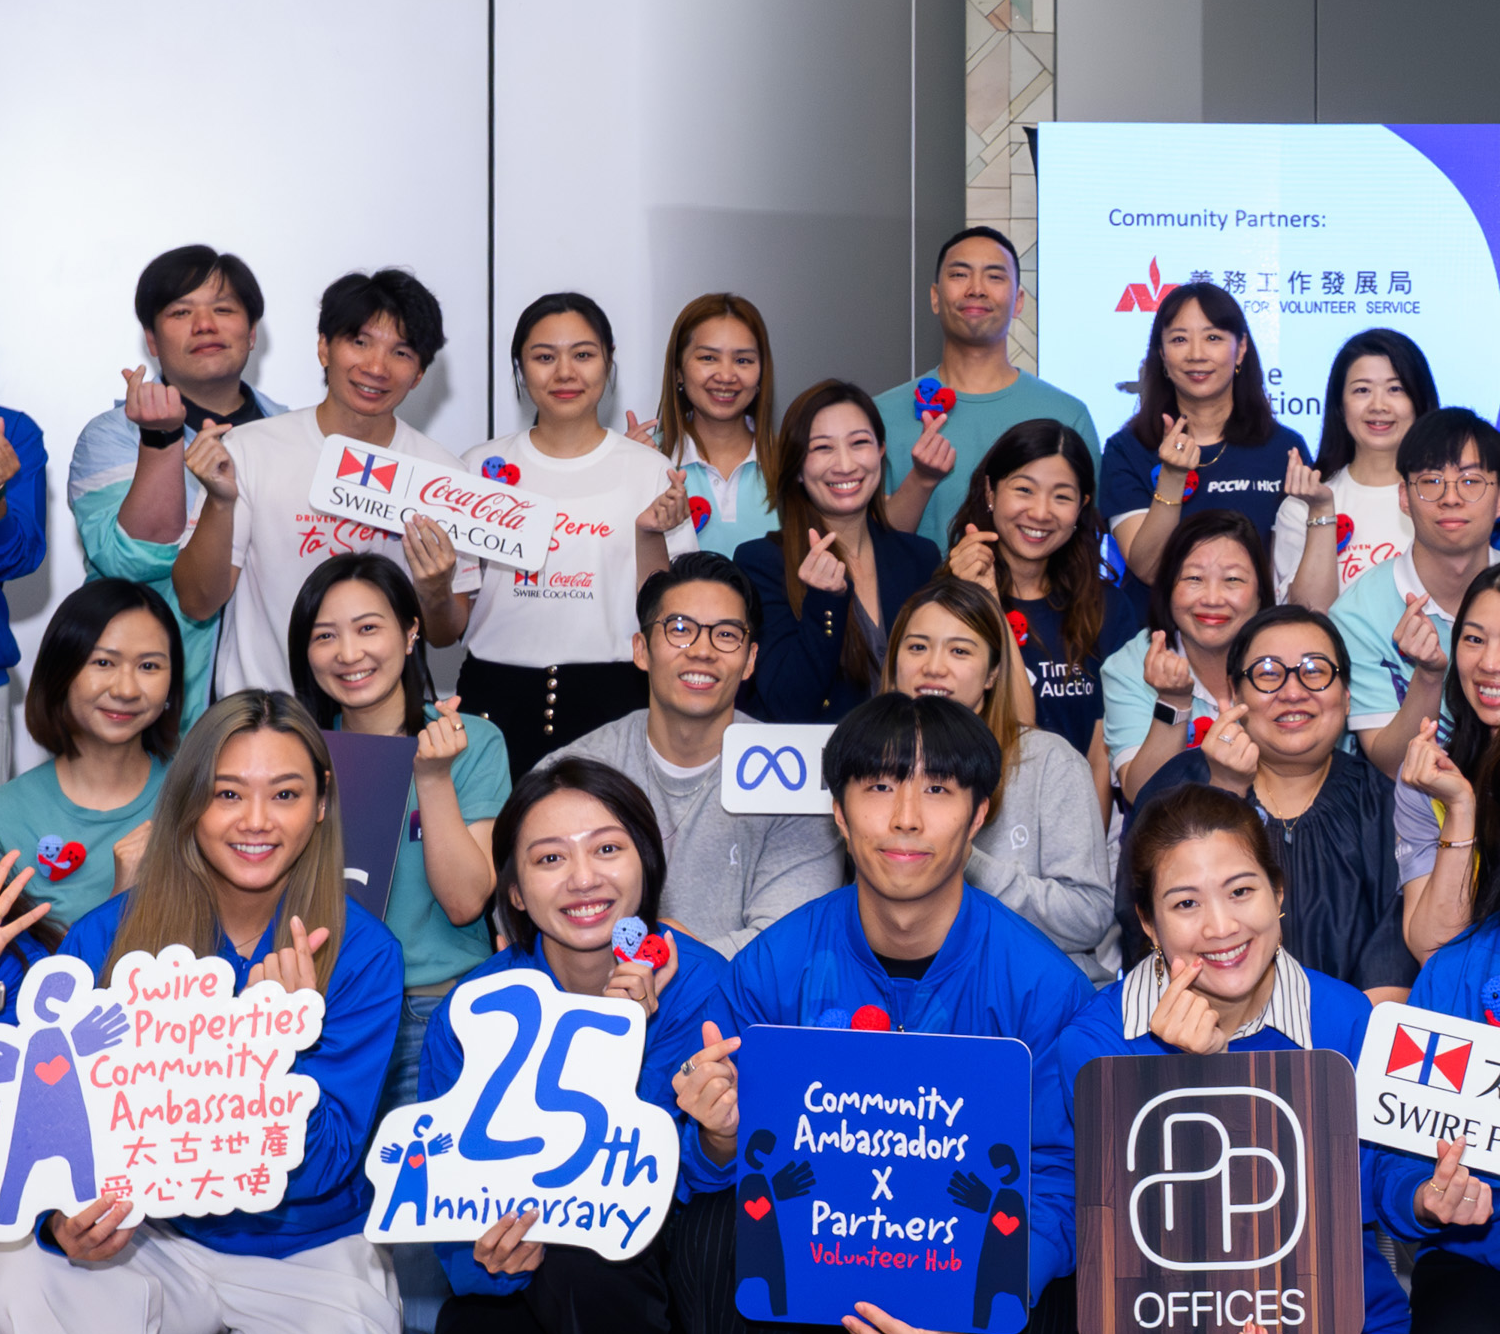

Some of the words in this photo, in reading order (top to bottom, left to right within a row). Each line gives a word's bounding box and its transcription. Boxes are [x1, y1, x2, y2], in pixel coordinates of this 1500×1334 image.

[1108, 208, 1228, 231] Community
[1235, 209, 1327, 229] Partners:
[1243, 300, 1270, 314] FOR
[1279, 300, 1357, 314] VOLUNTEER
[1365, 300, 1421, 315] SERVICE
[418, 474, 537, 532] Coca-Cola
[1206, 479, 1251, 494] PCCW
[1256, 478, 1282, 493] HKT
[295, 513, 338, 524] DRIVEN
[297, 524, 329, 558] to
[329, 485, 397, 521] SWIRE
[399, 506, 524, 559] CA-COLA
[512, 587, 540, 599] SWIRE
[542, 588, 594, 600] COCA-COLA
[127, 961, 219, 1006] Swire
[134, 997, 309, 1054] Properties
[89, 1043, 279, 1089] Community
[457, 984, 659, 1189] 25th
[110, 1083, 304, 1131] Ambassador
[803, 1080, 964, 1127] Community
[1372, 1091, 1482, 1149] SWIRE
[122, 1122, 291, 1169] 太古地產
[793, 1113, 969, 1162] Ambassadors
[100, 1163, 271, 1204] 愛心大使
[378, 1140, 651, 1250] Anniversary
[811, 1199, 959, 1244] Partners
[809, 1241, 919, 1270] Volunteer
[924, 1247, 962, 1272] Hub
[1133, 1288, 1306, 1329] OFFICES
